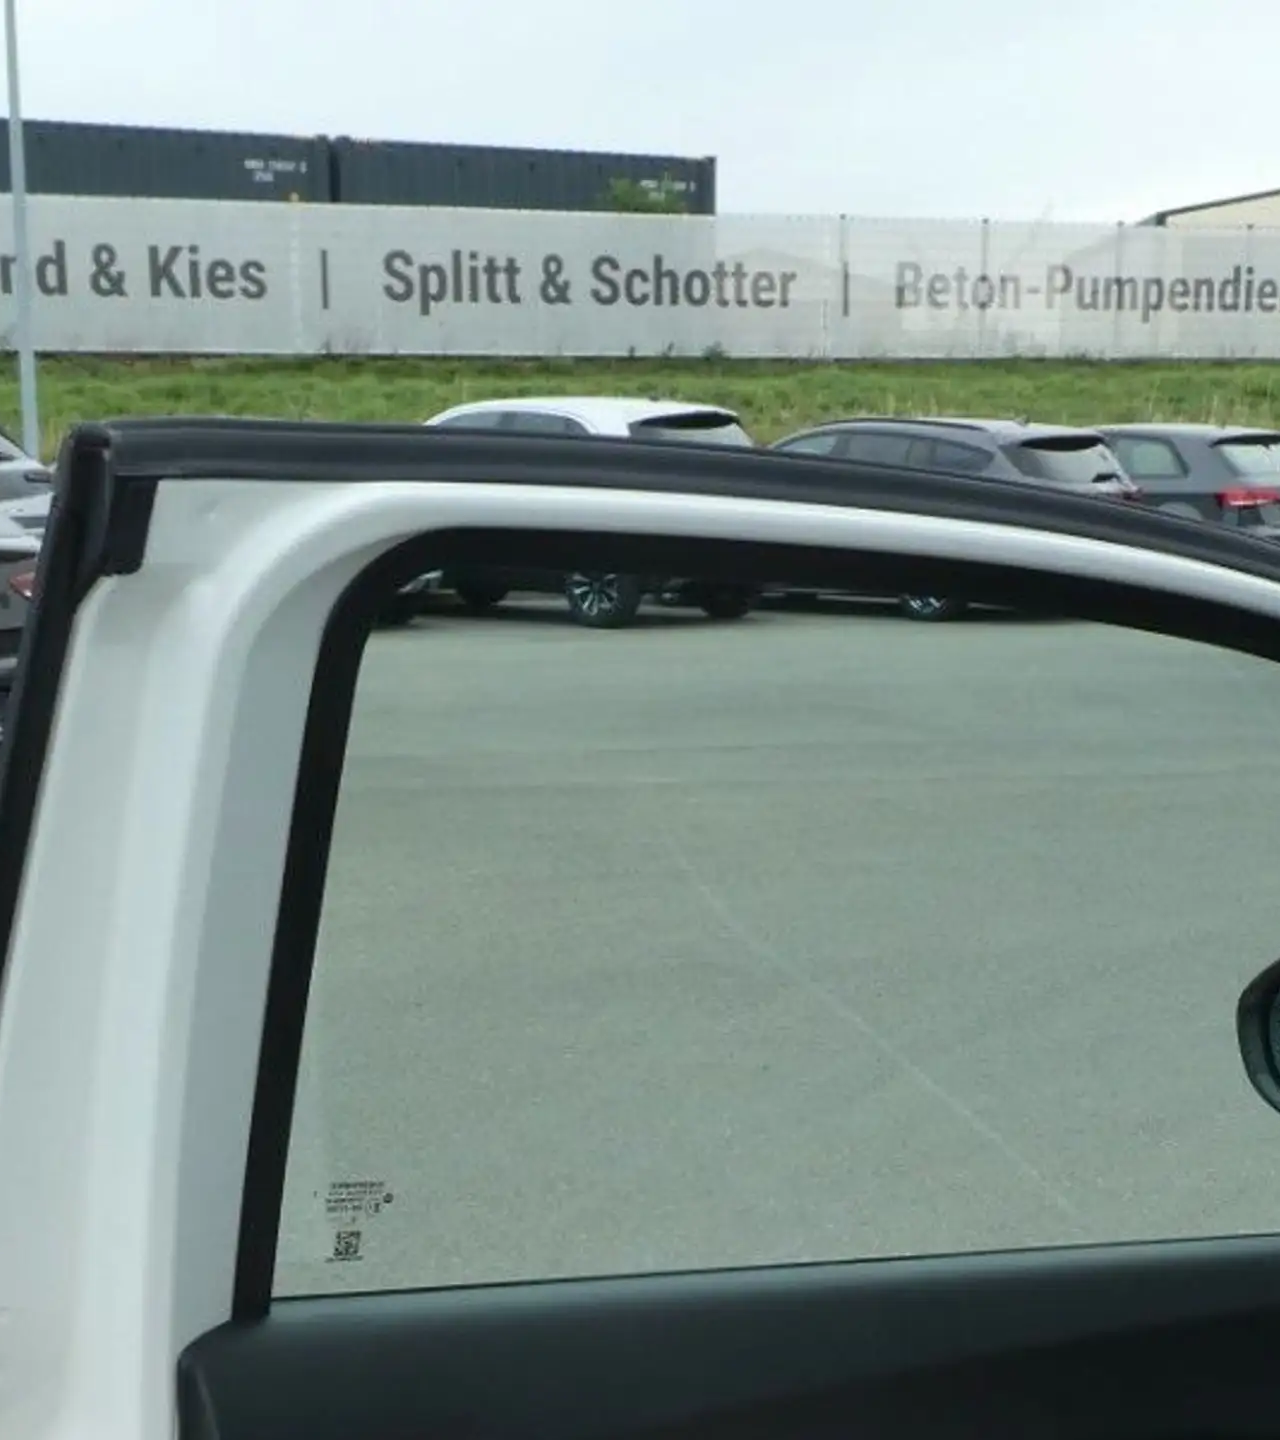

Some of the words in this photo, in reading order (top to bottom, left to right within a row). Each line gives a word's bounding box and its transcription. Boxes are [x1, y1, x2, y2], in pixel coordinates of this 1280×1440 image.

[89, 243, 128, 297] &
[148, 245, 267, 300] Kies
[383, 249, 521, 316] Splitt
[540, 253, 572, 305] &
[590, 254, 797, 308] Schotter
